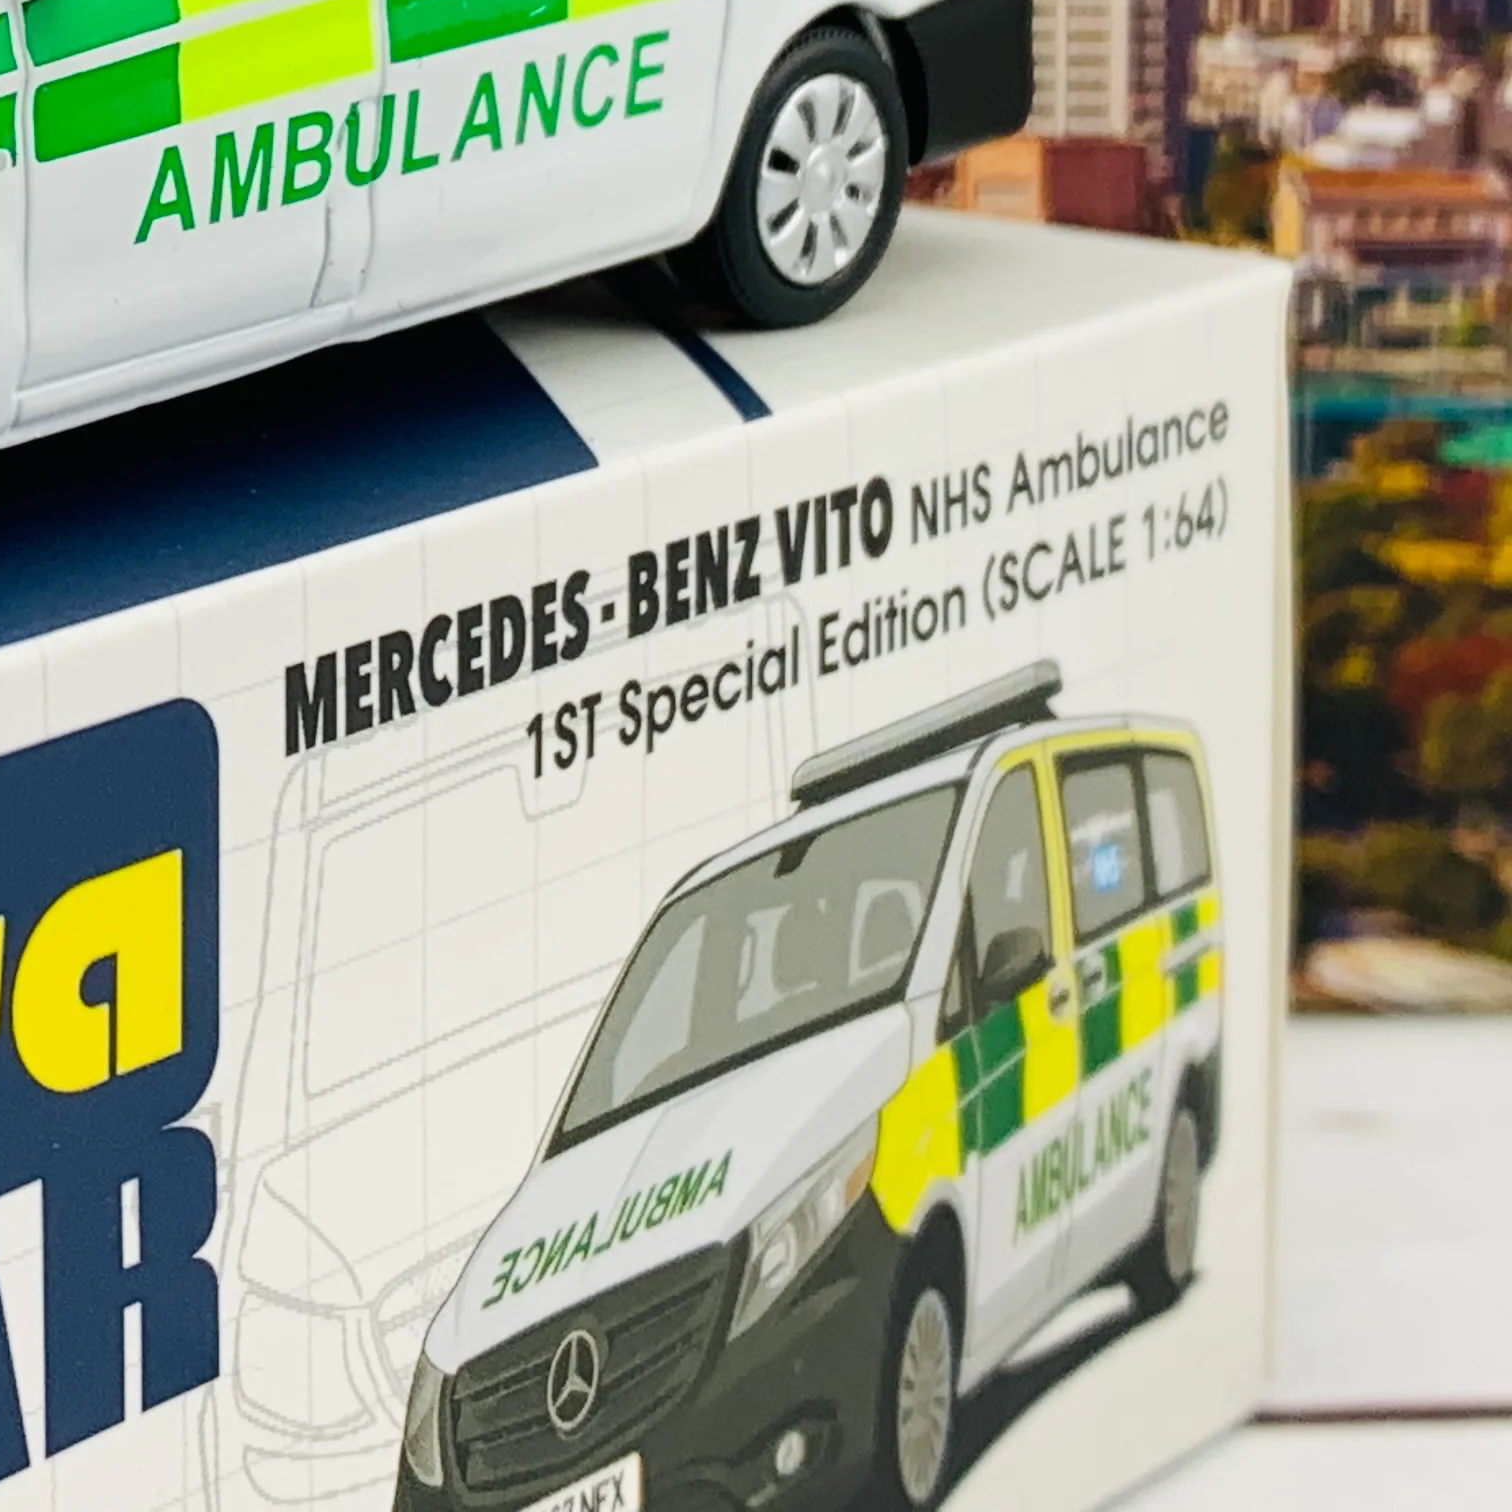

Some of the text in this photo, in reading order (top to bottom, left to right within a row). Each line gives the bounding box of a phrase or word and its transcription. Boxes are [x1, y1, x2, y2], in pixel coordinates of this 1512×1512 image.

[133, 29, 671, 245] AMBULANCE
[774, 475, 894, 586] VITO
[910, 461, 992, 545] NHS
[1005, 399, 1230, 514] Ambulance
[525, 475, 1229, 779] 1ST Special Edition (SCALE 1:64)
[1013, 1066, 1154, 1245] AMBULANCE
